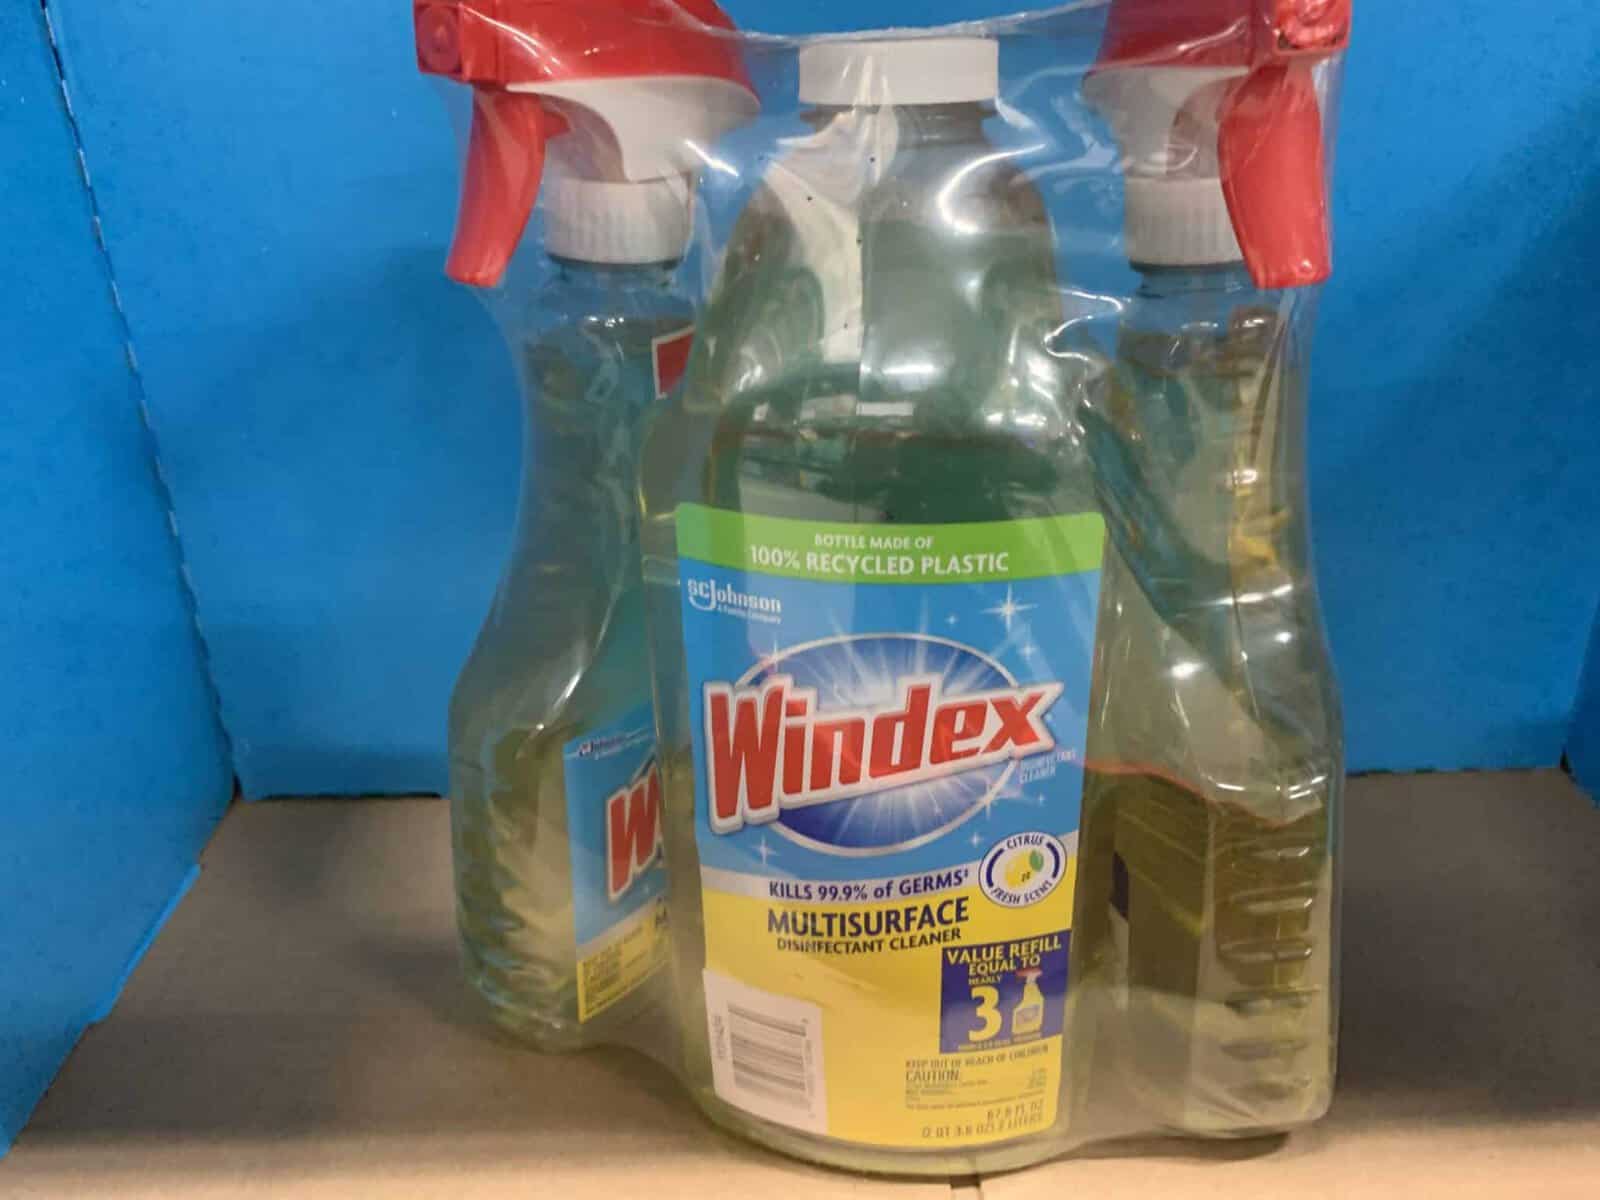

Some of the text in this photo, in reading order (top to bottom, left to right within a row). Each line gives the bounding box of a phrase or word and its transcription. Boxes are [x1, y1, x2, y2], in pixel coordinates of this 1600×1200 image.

[815, 533, 935, 551] BOTTLE MADE OF
[750, 545, 1010, 576] 100% RECYCLED PLASTIC
[704, 674, 1063, 834] Windex
[1006, 834, 1044, 849] CITRUS
[769, 881, 812, 900] KILLS
[818, 884, 868, 902] 99.9%
[873, 880, 894, 899] of
[990, 880, 1053, 904] FRESH SCENT
[768, 896, 970, 938] MULTISURFACE
[777, 927, 962, 955] DISINFECTANT CLEANER
[946, 935, 1062, 966] VALUE REFILL
[968, 955, 1041, 977] EQUAL TO
[968, 985, 1002, 1043] 3
